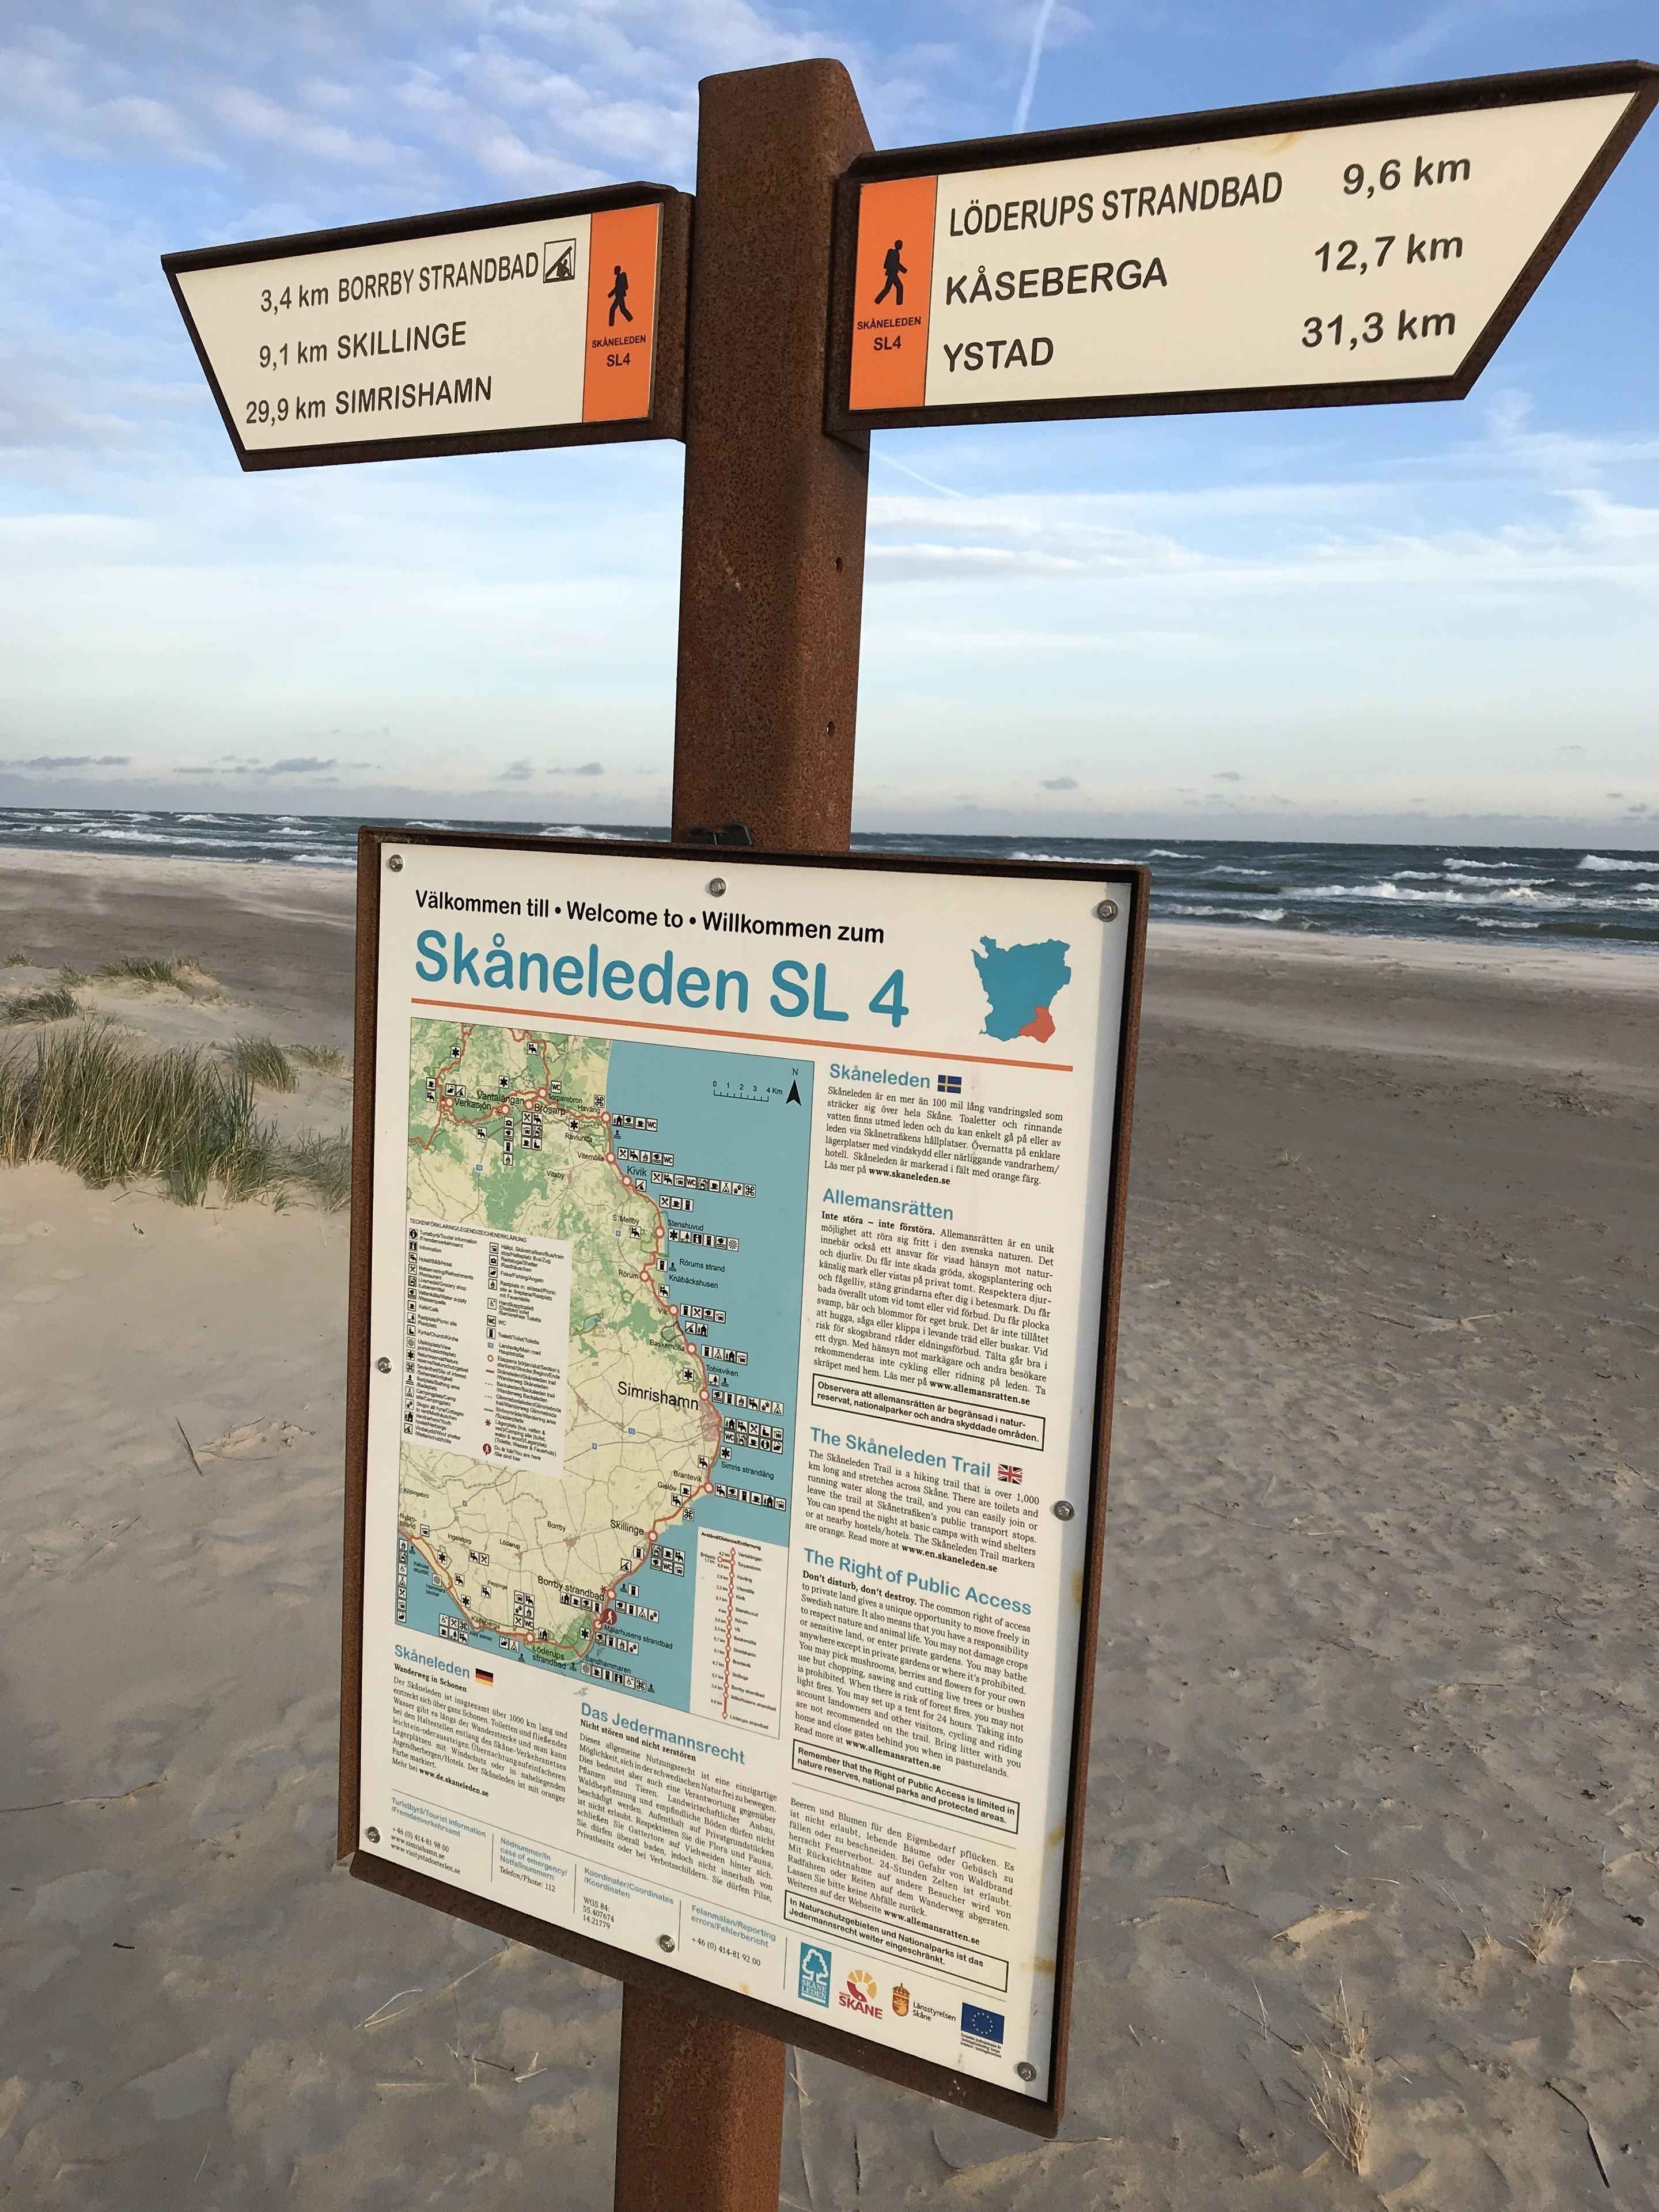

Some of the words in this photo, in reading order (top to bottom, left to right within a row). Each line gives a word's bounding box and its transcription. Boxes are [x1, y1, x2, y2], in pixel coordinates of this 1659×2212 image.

[950, 193, 1093, 237] LÖDERUPS
[1102, 172, 1282, 221] STRANDBAD
[1343, 159, 1401, 199] 9,6
[1414, 156, 1471, 187] km
[260, 286, 292, 316] 3,4
[298, 285, 328, 308] km
[339, 268, 414, 302] BORRBY
[419, 252, 539, 292] STRANDBAD
[946, 257, 1168, 305] KÅSEBERGA
[1315, 236, 1396, 275] 12,7
[1407, 233, 1463, 264] km
[857, 316, 922, 330] SKÅNELEDEN
[259, 343, 288, 372] 9,1
[297, 341, 327, 364] km
[337, 321, 467, 359] SKILLINGE
[592, 334, 646, 349] SKÅNELEDEN
[873, 335, 902, 351] SL4
[943, 337, 1054, 373] YSTAD
[1301, 312, 1384, 351] 31,3
[1397, 309, 1456, 341] km
[607, 352, 631, 367] SL4
[246, 397, 289, 427] 29,9
[296, 396, 325, 420] km
[335, 375, 491, 415] SIMRISHAMN
[415, 889, 521, 915] Välkommen
[526, 897, 548, 918] till
[566, 900, 657, 926] Welcome
[663, 908, 683, 928] to
[702, 910, 831, 940] Willkommen
[837, 925, 884, 944] zum
[415, 929, 748, 1013] Skåneleden
[770, 959, 849, 1021] SL
[868, 969, 909, 1028] 4
[829, 1063, 930, 1089] Skåneleden
[454, 1099, 491, 1111] Verkasjön
[476, 1090, 524, 1105] Vantalängan
[828, 1086, 872, 1099] Skåneleden
[874, 1092, 883, 1100] är
[918, 1096, 928, 1105] än
[949, 1100, 963, 1109] mil
[966, 1101, 984, 1114] lång
[988, 1105, 1041, 1119] vandringsled
[1044, 1112, 1063, 1120] som
[627, 1166, 646, 1177] Kivik
[824, 1160, 838, 1169] Läs
[857, 1165, 866, 1174] på
[868, 1168, 950, 1185] www.skaneleden.se
[822, 1188, 953, 1220] Allemansrätten
[821, 1210, 838, 1221] Inte
[842, 1215, 863, 1224] störa
[878, 1218, 895, 1229] inte
[940, 1228, 1003, 1245] Allemansrätten
[1007, 1238, 1016, 1247] är
[1035, 1244, 1054, 1253] unik
[617, 1380, 699, 1411] Simrishamn
[817, 1381, 859, 1396] Observera
[861, 1390, 872, 1399] att
[873, 1392, 935, 1411] allemansrätten
[937, 1404, 946, 1412] är
[948, 1406, 993, 1422] begränsad
[995, 1415, 998, 1423] i
[853, 1400, 912, 1416] nationalparker
[913, 1412, 929, 1420] och
[930, 1415, 955, 1425] andra
[956, 1419, 997, 1434] skyddade
[810, 1426, 840, 1446] The
[845, 1434, 946, 1468] Skåneleden
[951, 1455, 990, 1478] Trail
[804, 1547, 834, 1568] The
[839, 1556, 882, 1580] Right
[885, 1569, 903, 1584] of
[907, 1571, 960, 1597] Public
[965, 1586, 1031, 1615] Access
[919, 1598, 934, 1609] The
[935, 1604, 970, 1618] common
[972, 1612, 992, 1623] right
[994, 1618, 1003, 1626] of
[1004, 1621, 1031, 1633] access
[393, 1662, 430, 1682] Wanderweg
[431, 1675, 438, 1683] in
[439, 1677, 467, 1692] Schonen
[394, 1644, 469, 1679] Skåneleden
[580, 1718, 599, 1731] Nicht
[601, 1727, 623, 1739] stören
[625, 1734, 639, 1744] und
[641, 1738, 660, 1750] nicht
[662, 1746, 696, 1762] zerstören
[581, 1702, 608, 1722] Das
[611, 1713, 745, 1764] Jedermannsrecht
[794, 1722, 812, 1735] Read
[815, 1730, 834, 1741] more
[845, 1739, 941, 1771] www.allemansratten.se
[797, 1758, 823, 1770] nature
[862, 1777, 894, 1791] national
[896, 1786, 919, 1798] parks
[921, 1794, 936, 1803] and
[938, 1798, 979, 1815] protected
[798, 1747, 840, 1765] Remember
[842, 1759, 858, 1770] that
[859, 1764, 872, 1774] the
[874, 1768, 895, 1781] Right
[908, 1778, 933, 1791] Public
[934, 1786, 965, 1801] Access
[967, 1795, 975, 1804] is
[976, 1797, 1005, 1812] limited
[1007, 1806, 1014, 1815] in
[583, 1896, 599, 1908] WGS
[801, 1986, 827, 1999] LEDEN
[912, 2001, 956, 2021] Länsstyrelsen
[912, 2009, 931, 2021] Skåne
